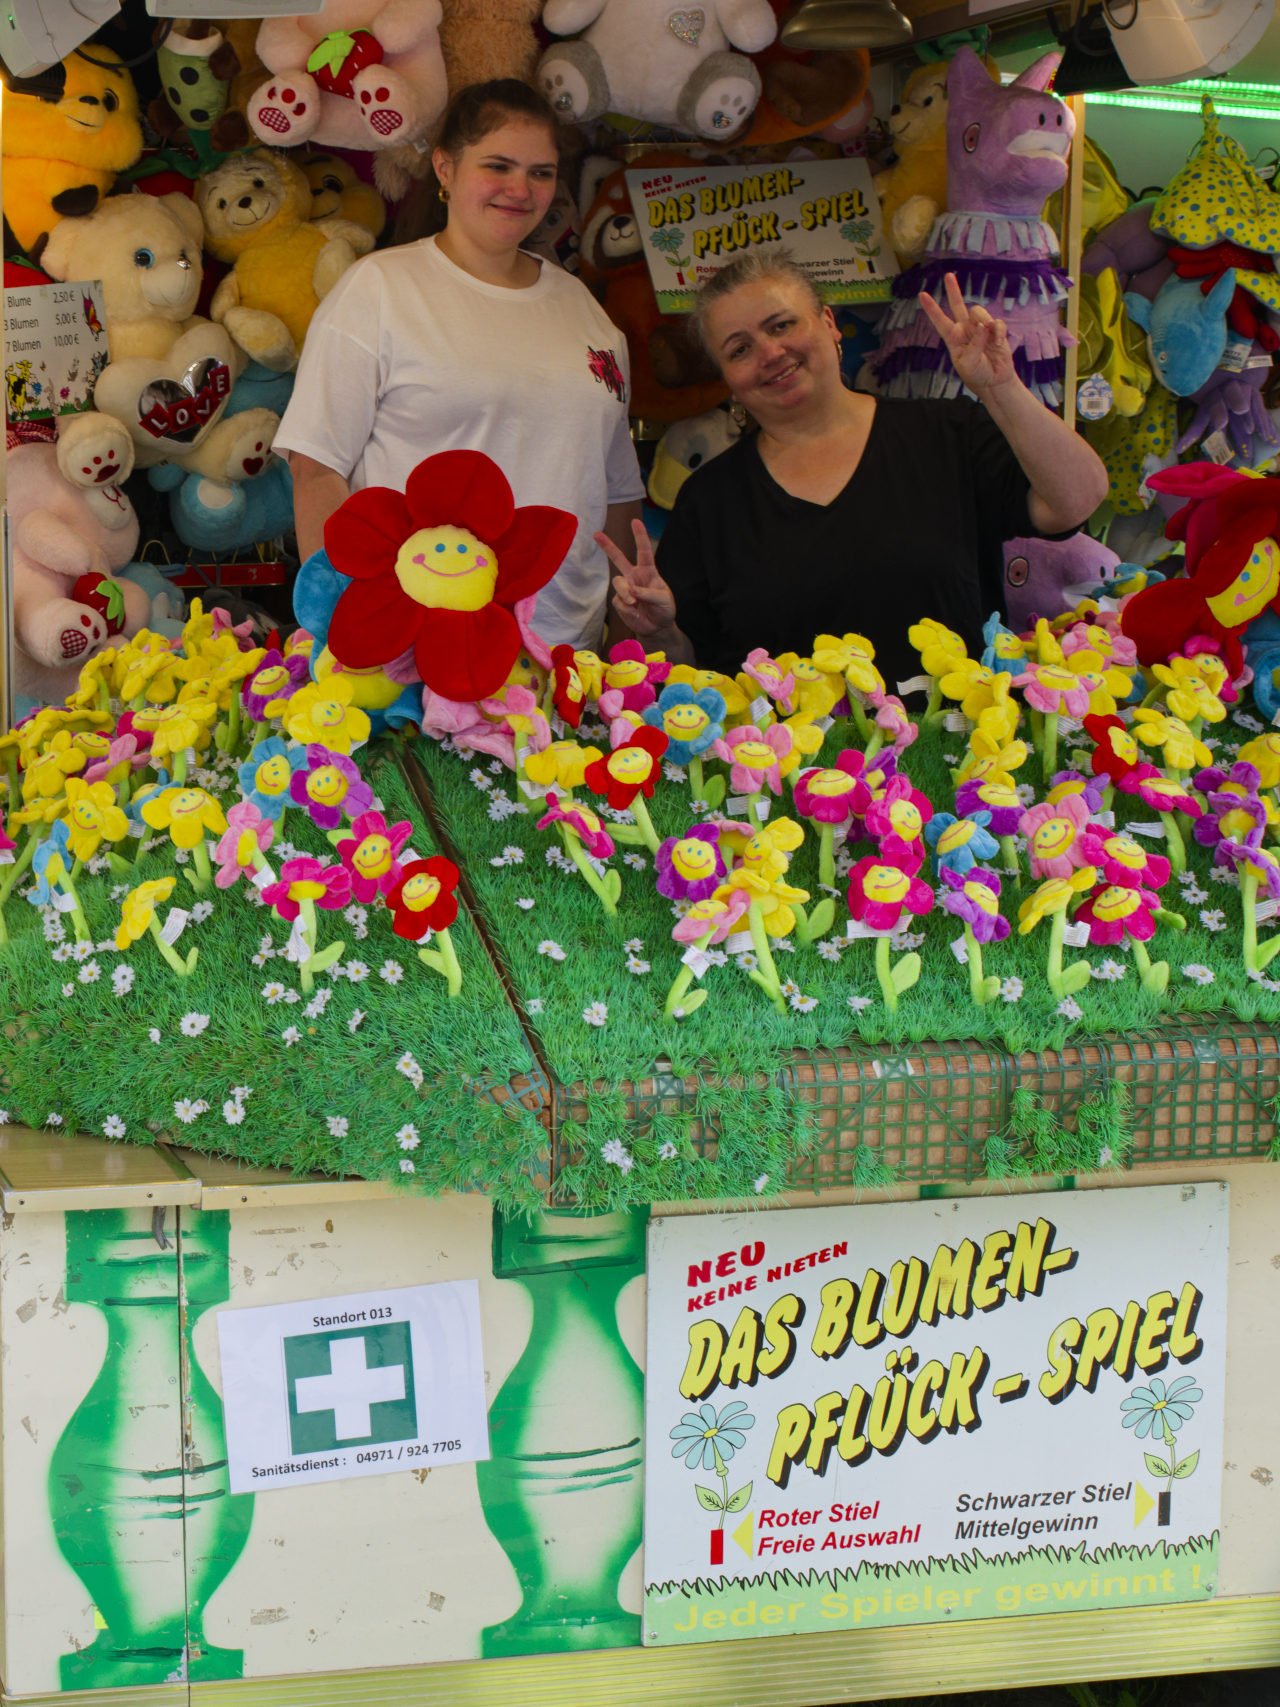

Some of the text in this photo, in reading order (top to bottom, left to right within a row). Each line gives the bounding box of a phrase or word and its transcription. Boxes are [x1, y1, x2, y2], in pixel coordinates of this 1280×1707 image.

[642, 175, 673, 190] NEU
[648, 168, 804, 228] DAS BLUMEN-
[693, 211, 780, 259] PFLÜCK
[800, 188, 868, 231] SPIEL
[807, 268, 844, 278] gewinn
[833, 257, 855, 266] Stiel
[7, 296, 32, 308] Blume
[832, 287, 886, 300] winnt
[10, 318, 39, 330] Blumen
[6, 341, 11, 352] 7
[12, 340, 41, 352] Blumen
[151, 374, 225, 430] LOVE
[687, 1241, 765, 1287] NEU
[687, 1241, 848, 1313] KEINE NIETEN
[313, 1307, 393, 1327] Standort 013
[678, 1216, 1079, 1403] DAS BLUMEN-
[765, 1345, 990, 1490] PFLÜCK
[1037, 1280, 1204, 1406] SPIEL
[251, 1457, 340, 1478] Sanitätsdienst
[356, 1449, 394, 1464] 04971
[406, 1444, 430, 1457] 924
[432, 1439, 462, 1454] 7705
[955, 1482, 1132, 1513] Schwarzer Stiel
[757, 1501, 880, 1530] Roter Stiel
[954, 1513, 1099, 1542] Mittelgewinn
[757, 1525, 921, 1557] Freie Auswahl
[673, 1598, 805, 1633] Jeder
[820, 1577, 981, 1624] Spieler
[995, 1564, 1176, 1613] gewinnt
